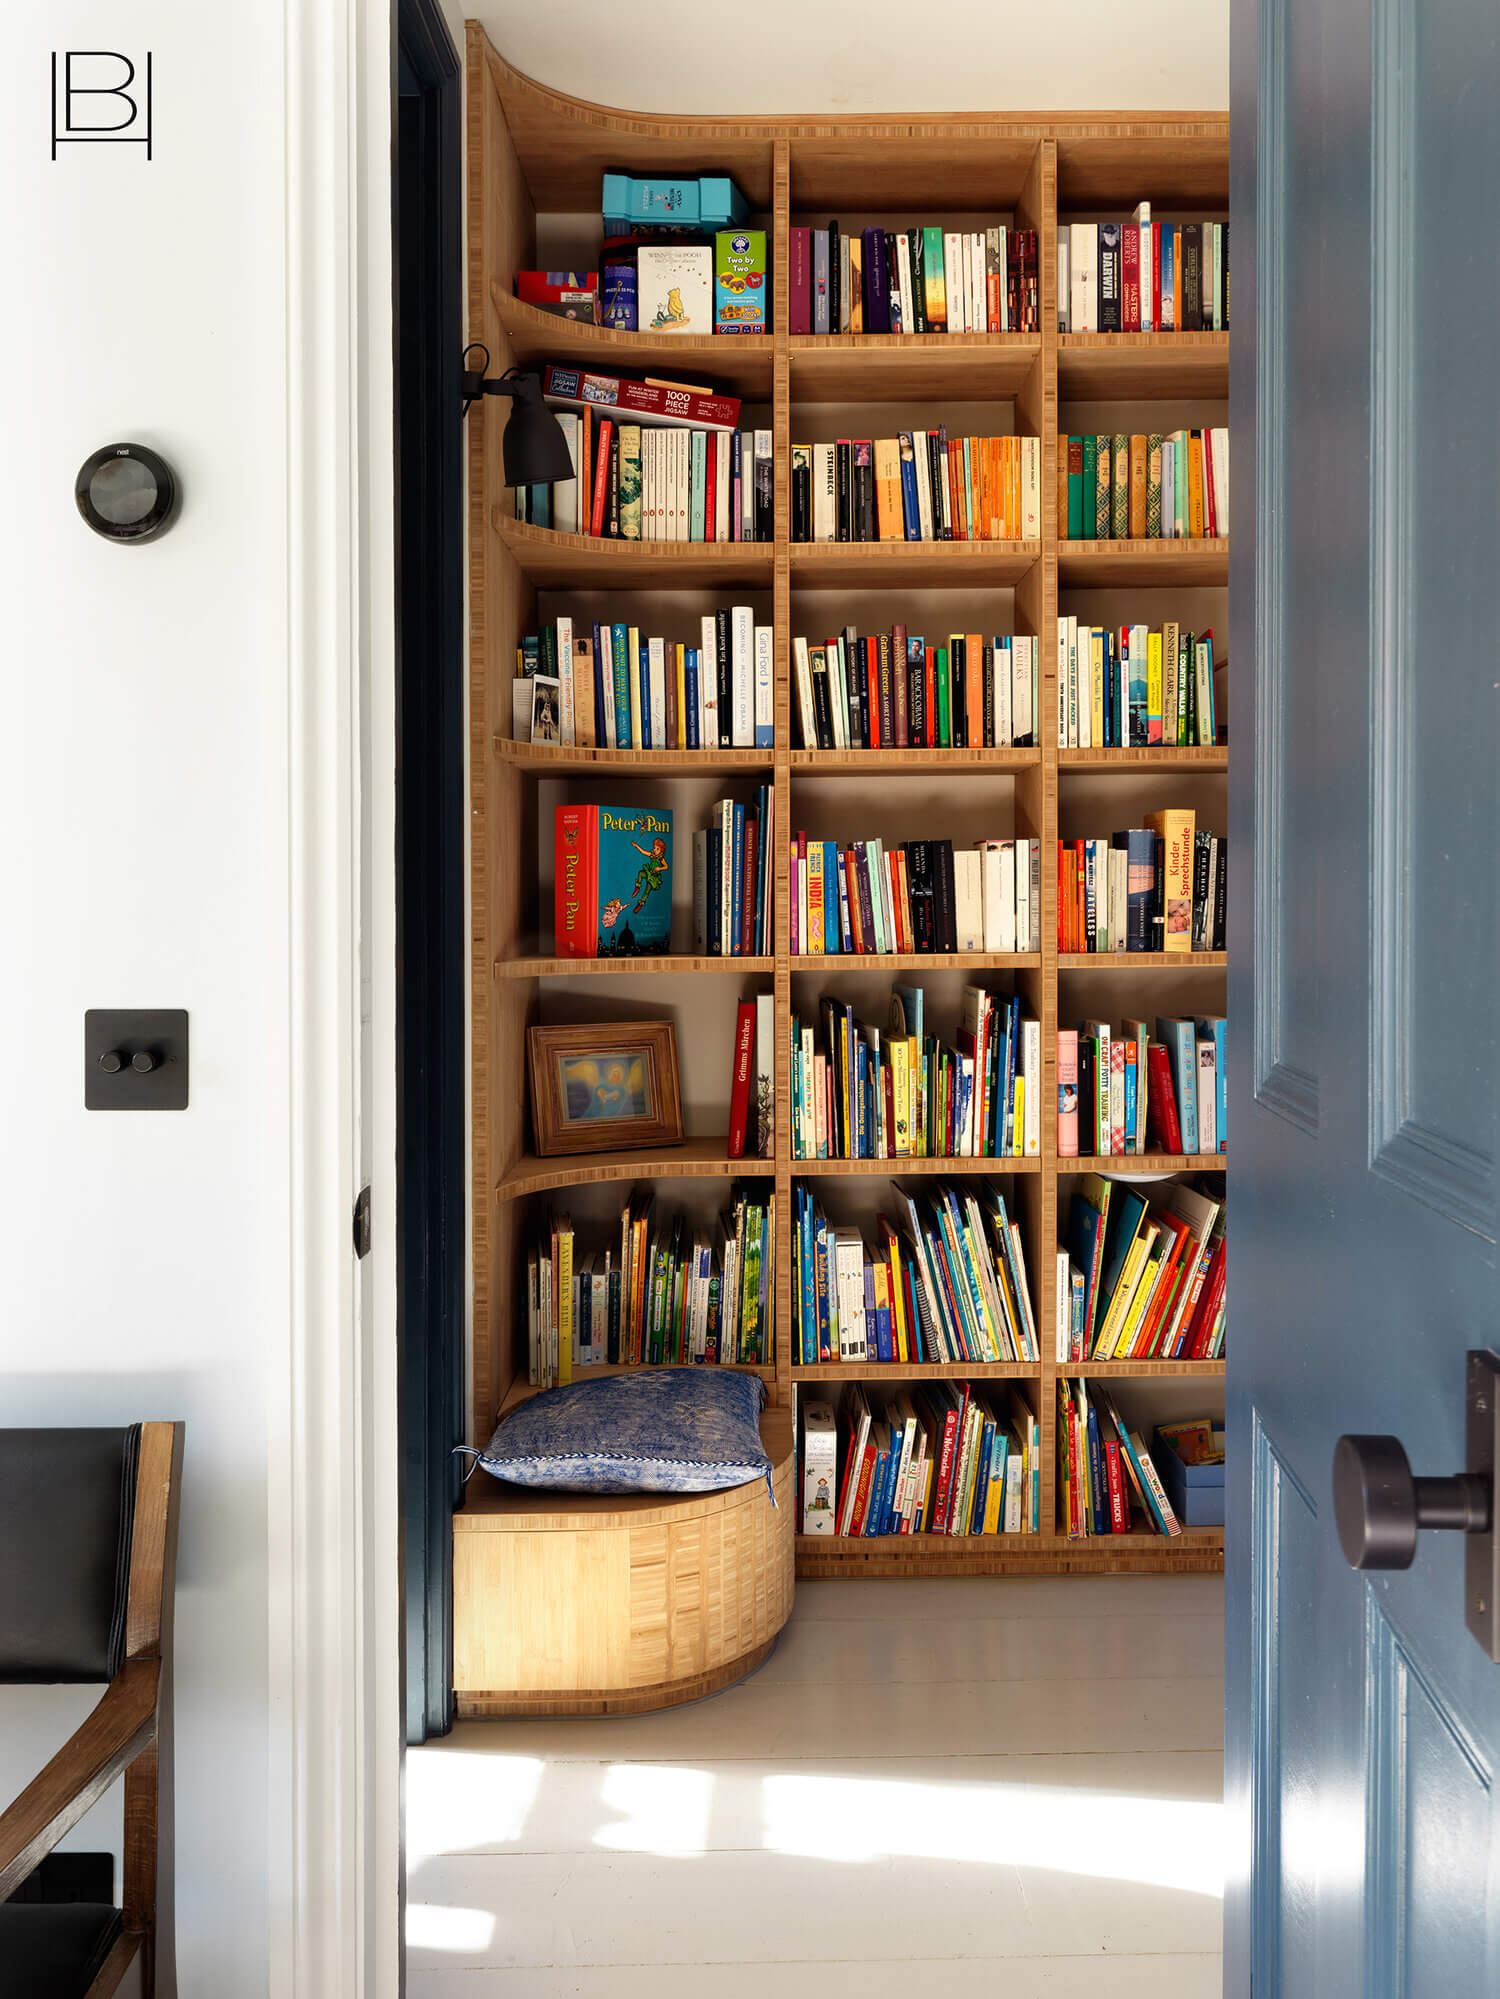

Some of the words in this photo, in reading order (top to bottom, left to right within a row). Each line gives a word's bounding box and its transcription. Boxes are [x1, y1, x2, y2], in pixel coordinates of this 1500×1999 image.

[727, 256, 743, 264] Two
[745, 256, 755, 266] by
[1103, 252, 1113, 299] DARWIN
[665, 400, 689, 410] PIECE
[666, 390, 691, 402] 1000
[664, 408, 689, 416] JIGSAW
[826, 450, 834, 496] STEINBECK
[759, 632, 769, 654] Gina
[880, 635, 889, 668] Graham
[1167, 625, 1175, 665] KENNETH
[759, 656, 769, 677] Ford
[1167, 667, 1175, 695] CLARK
[881, 668, 890, 695] Greene
[600, 812, 638, 831] Peter
[646, 815, 670, 833] Pan
[1169, 840, 1180, 876] Kinder
[1180, 827, 1191, 896] Sprechstunde
[565, 851, 580, 897] Peter
[1200, 850, 1208, 898] CHEKHOV
[809, 876, 823, 909] INDIA
[565, 902, 580, 931] Pan
[1087, 890, 1095, 937] FATELESS
[739, 1018, 750, 1051] Märchen
[1101, 1036, 1109, 1045] OH
[738, 1053, 748, 1082] Grimms
[1101, 1046, 1109, 1066] CRAP!
[1101, 1068, 1109, 1088] POTTY
[1101, 1089, 1109, 1122] TRAINING
[817, 1253, 827, 1282] Building
[818, 1283, 827, 1297] Site
[945, 1427, 953, 1437] The
[940, 1437, 953, 1478] Nutcracker
[859, 1458, 871, 1499] GOODNIGHT
[853, 1501, 864, 1522] MOON
[1113, 1493, 1122, 1522] TRUCKS
